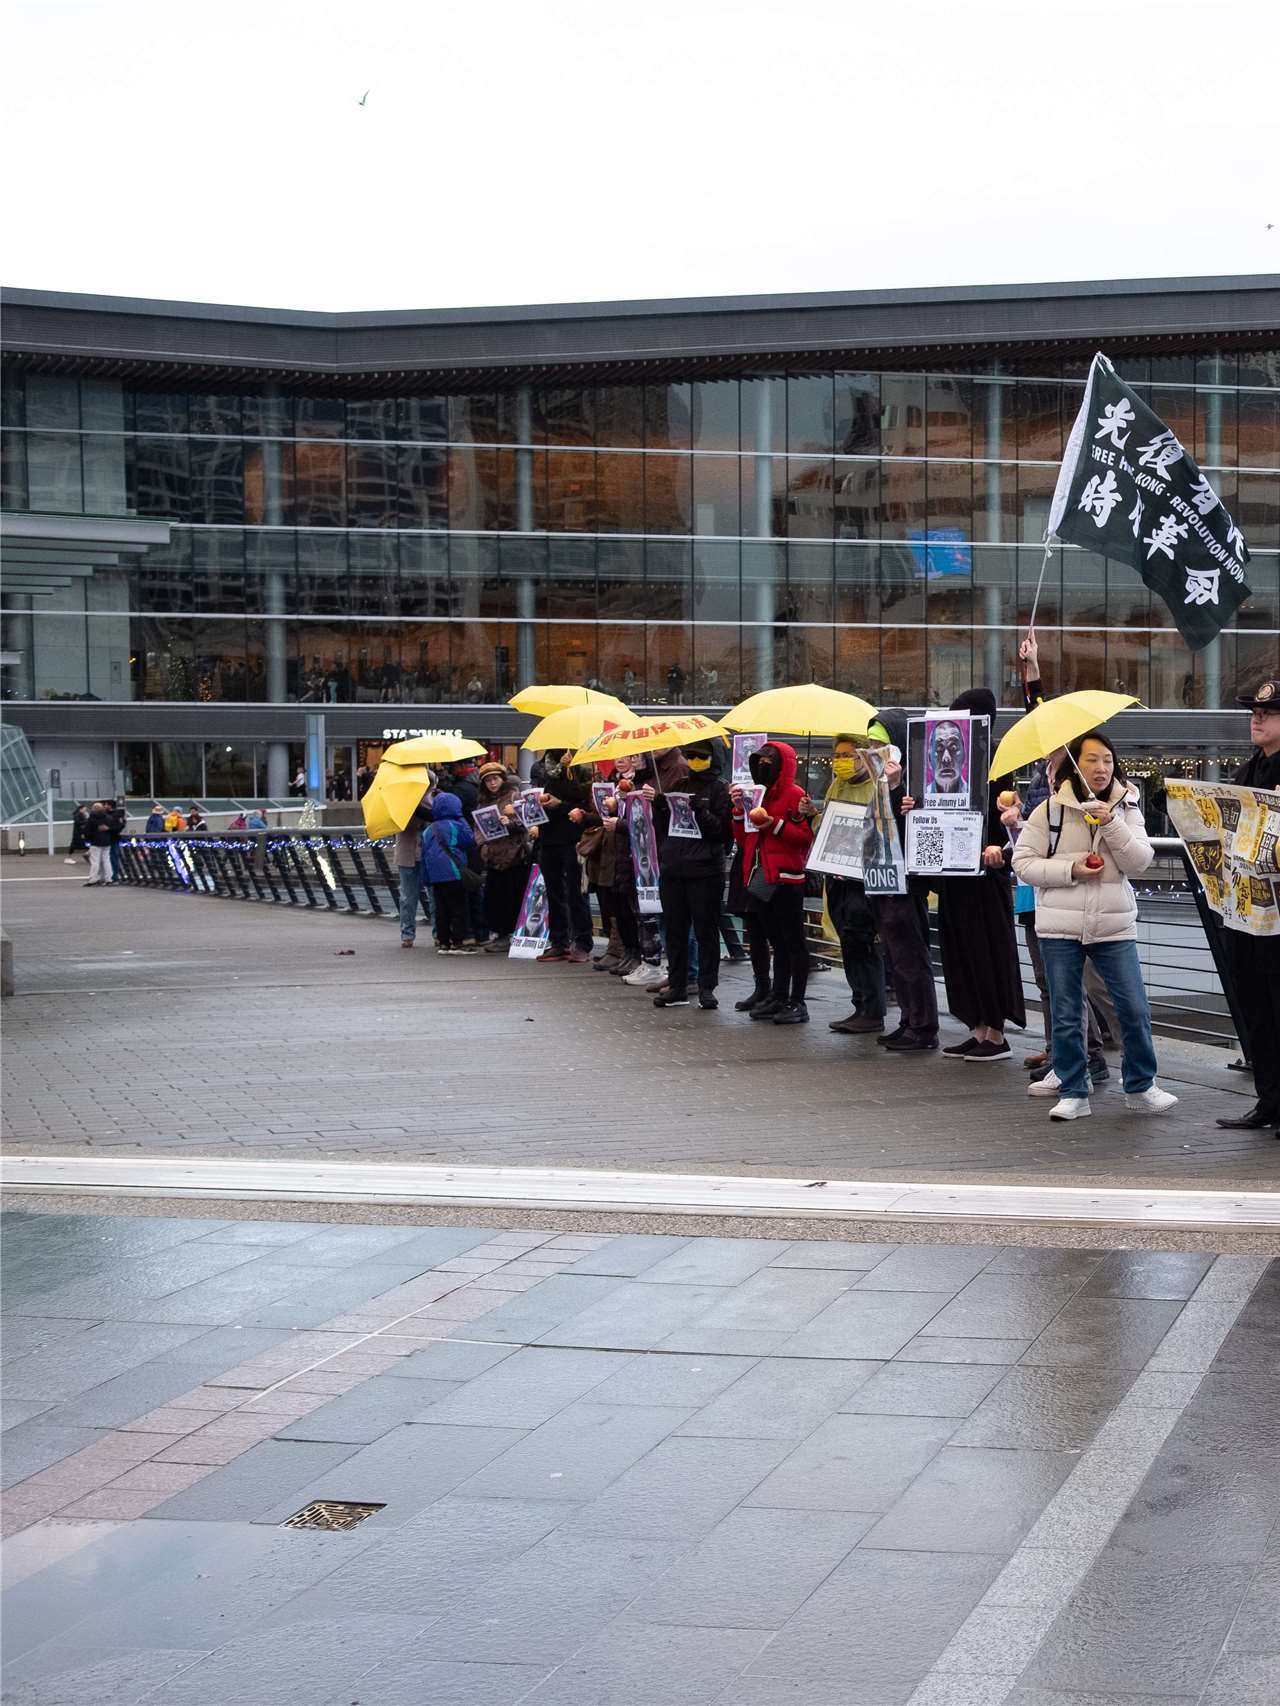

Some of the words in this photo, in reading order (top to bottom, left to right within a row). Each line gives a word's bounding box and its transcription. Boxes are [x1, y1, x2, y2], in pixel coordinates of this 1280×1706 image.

[1135, 472, 1166, 495] KONG
[1169, 495, 1229, 562] REVOLUTION
[1223, 556, 1245, 584] NOW
[1127, 769, 1150, 778] chop
[938, 799, 957, 807] Jimmy
[912, 816, 931, 824] Follow
[931, 816, 938, 824] Us
